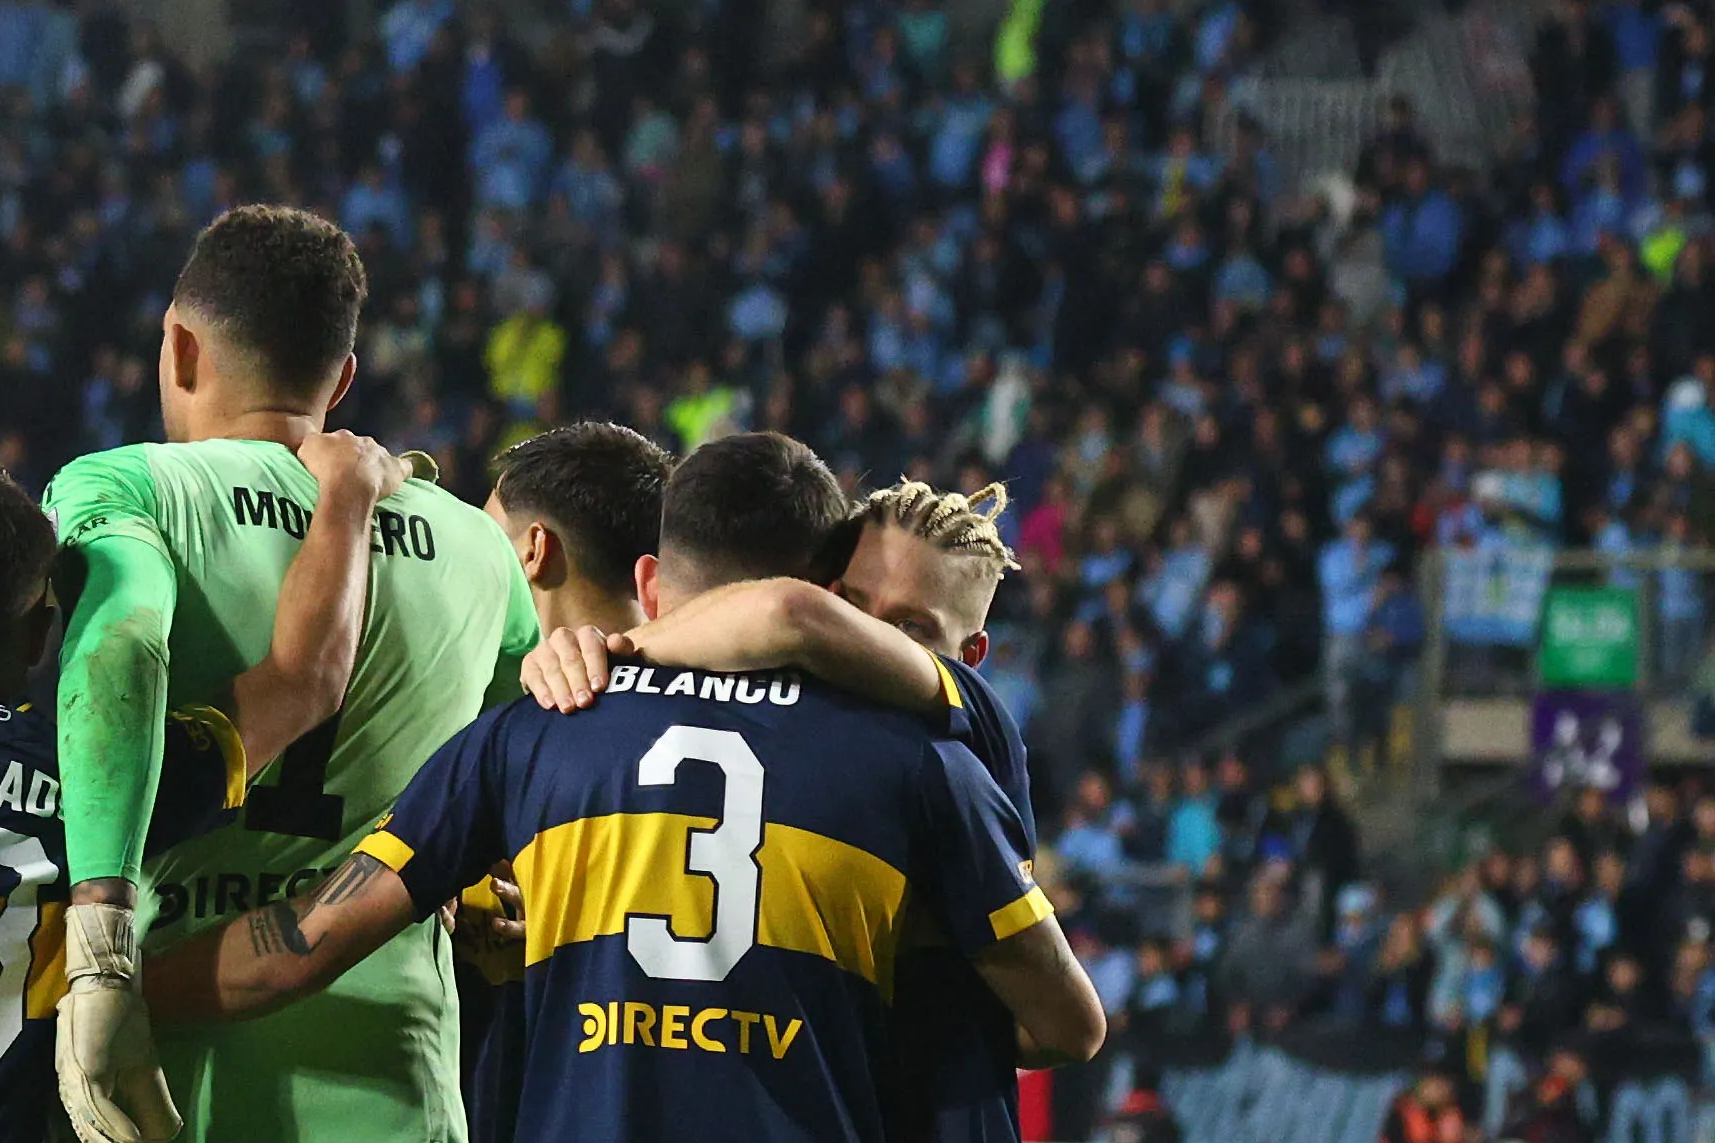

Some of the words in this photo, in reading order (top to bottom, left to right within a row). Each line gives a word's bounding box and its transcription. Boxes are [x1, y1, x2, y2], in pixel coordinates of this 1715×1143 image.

[605, 664, 802, 706] BLANCO
[627, 725, 765, 982] 3
[578, 1002, 803, 1060] DIRECTV
